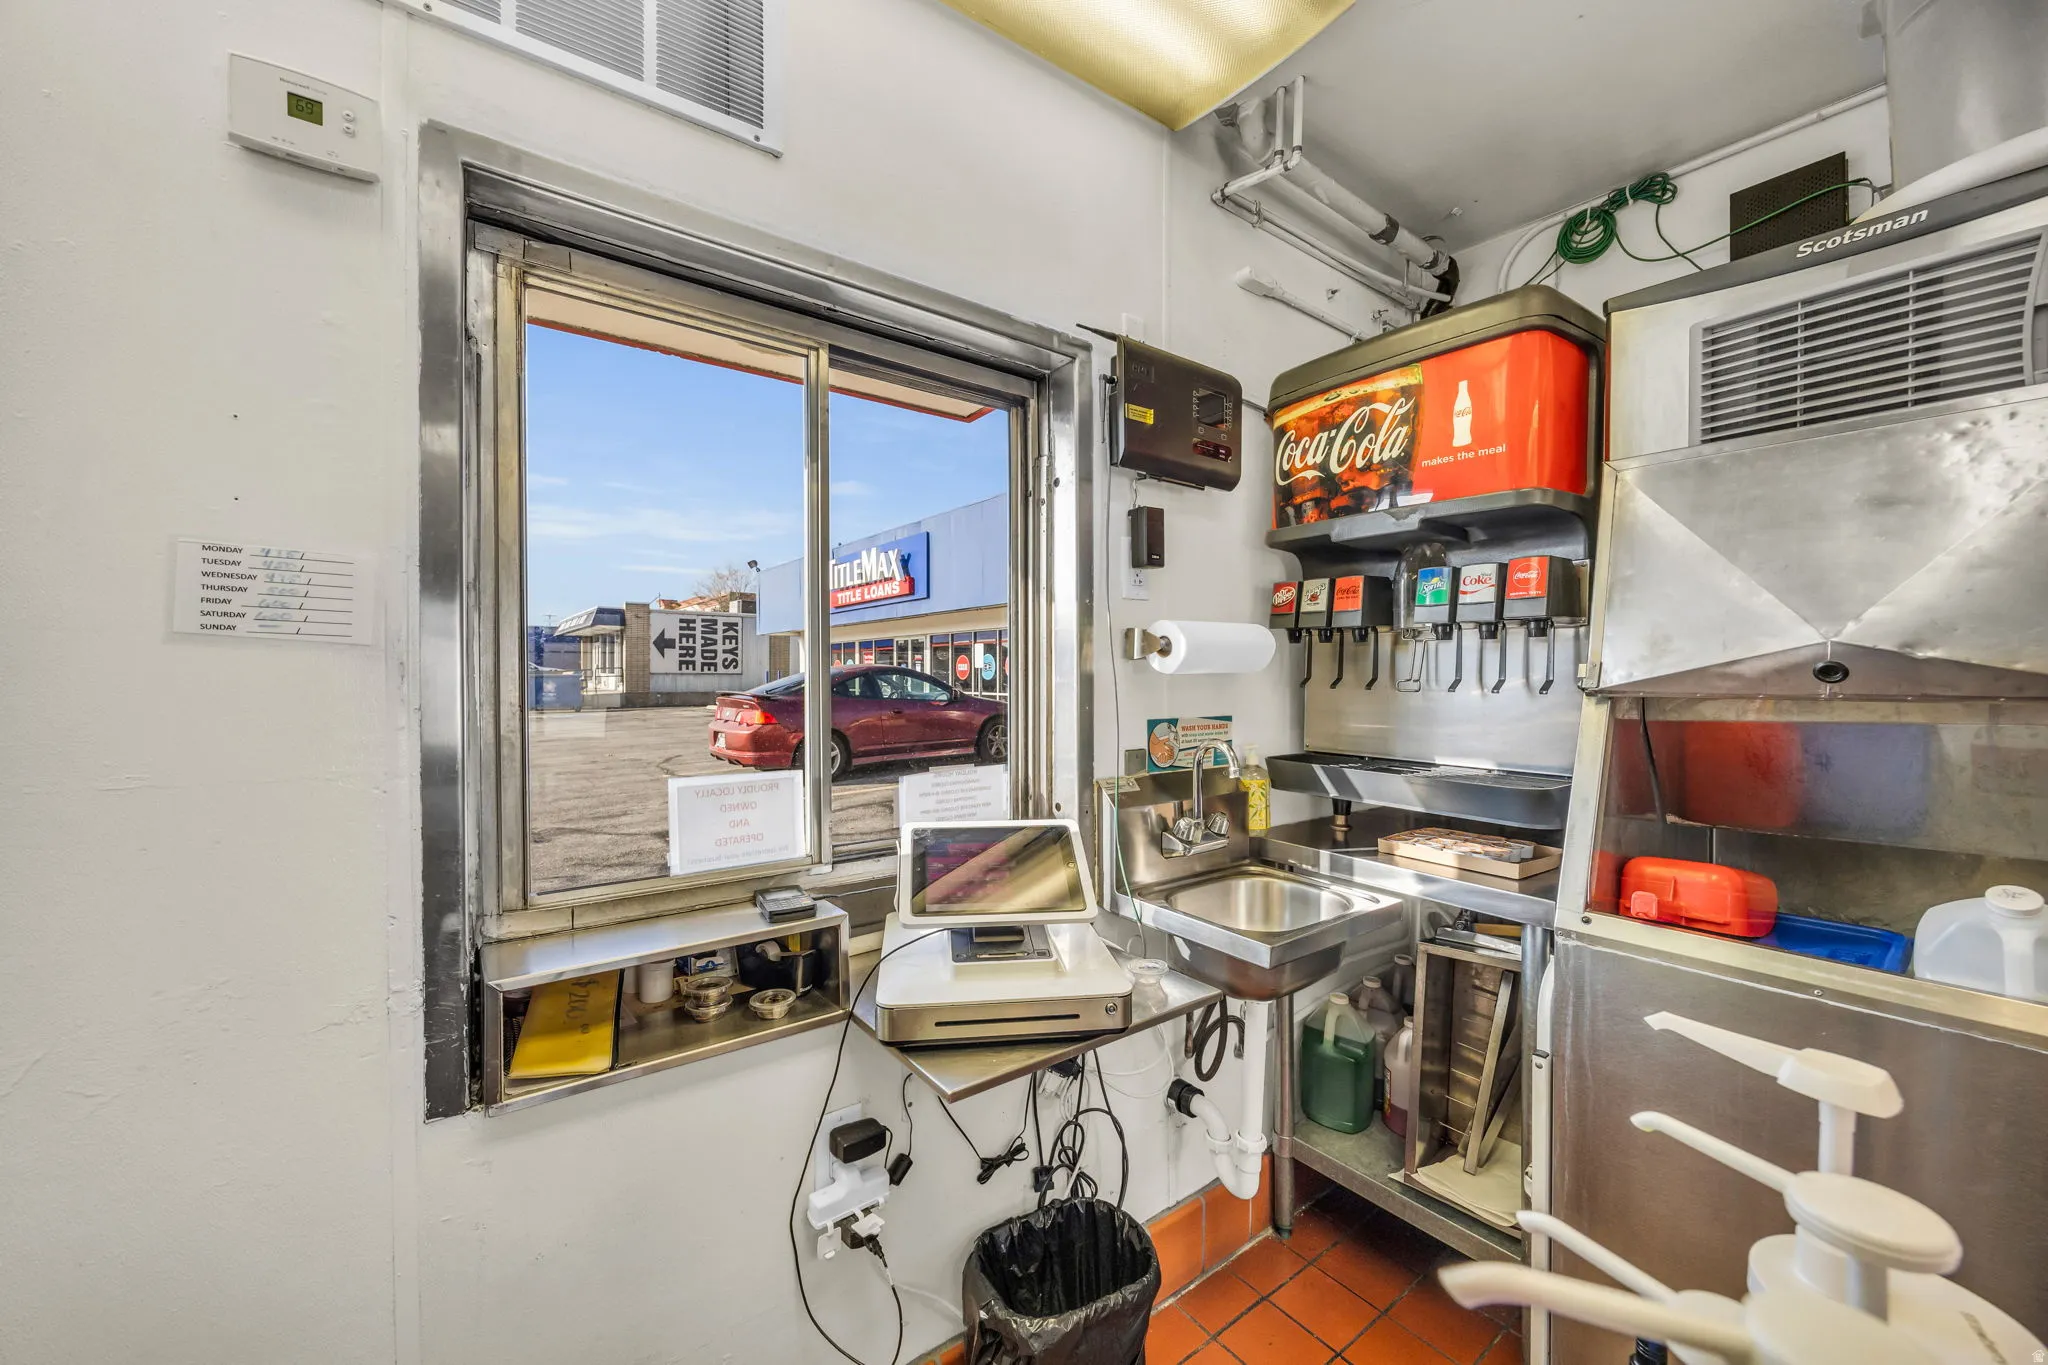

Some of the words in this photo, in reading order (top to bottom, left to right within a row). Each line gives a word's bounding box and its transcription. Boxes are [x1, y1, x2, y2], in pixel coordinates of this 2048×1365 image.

[295, 99, 314, 115] 69
[1796, 209, 1929, 258] Scotsman
[1275, 397, 1416, 485] Coca-Cola
[1422, 455, 1454, 468] makes
[1457, 450, 1475, 461] the
[1478, 444, 1507, 456] meal
[201, 544, 243, 554] MONDAY
[201, 557, 242, 567] TUESDAY
[201, 571, 258, 581] WEDNESDAY
[1462, 575, 1493, 587] Coke
[201, 584, 248, 593] THURSDAY
[837, 588, 861, 604] TITLE
[864, 581, 900, 599] LOANS
[1422, 578, 1446, 594] Sprite
[200, 597, 233, 605] FRIDAY
[200, 610, 247, 619] SATURDAY
[200, 623, 237, 631] SUNDAY
[678, 618, 697, 671] HERE
[700, 618, 718, 672] MADE
[721, 621, 739, 670] KEYS
